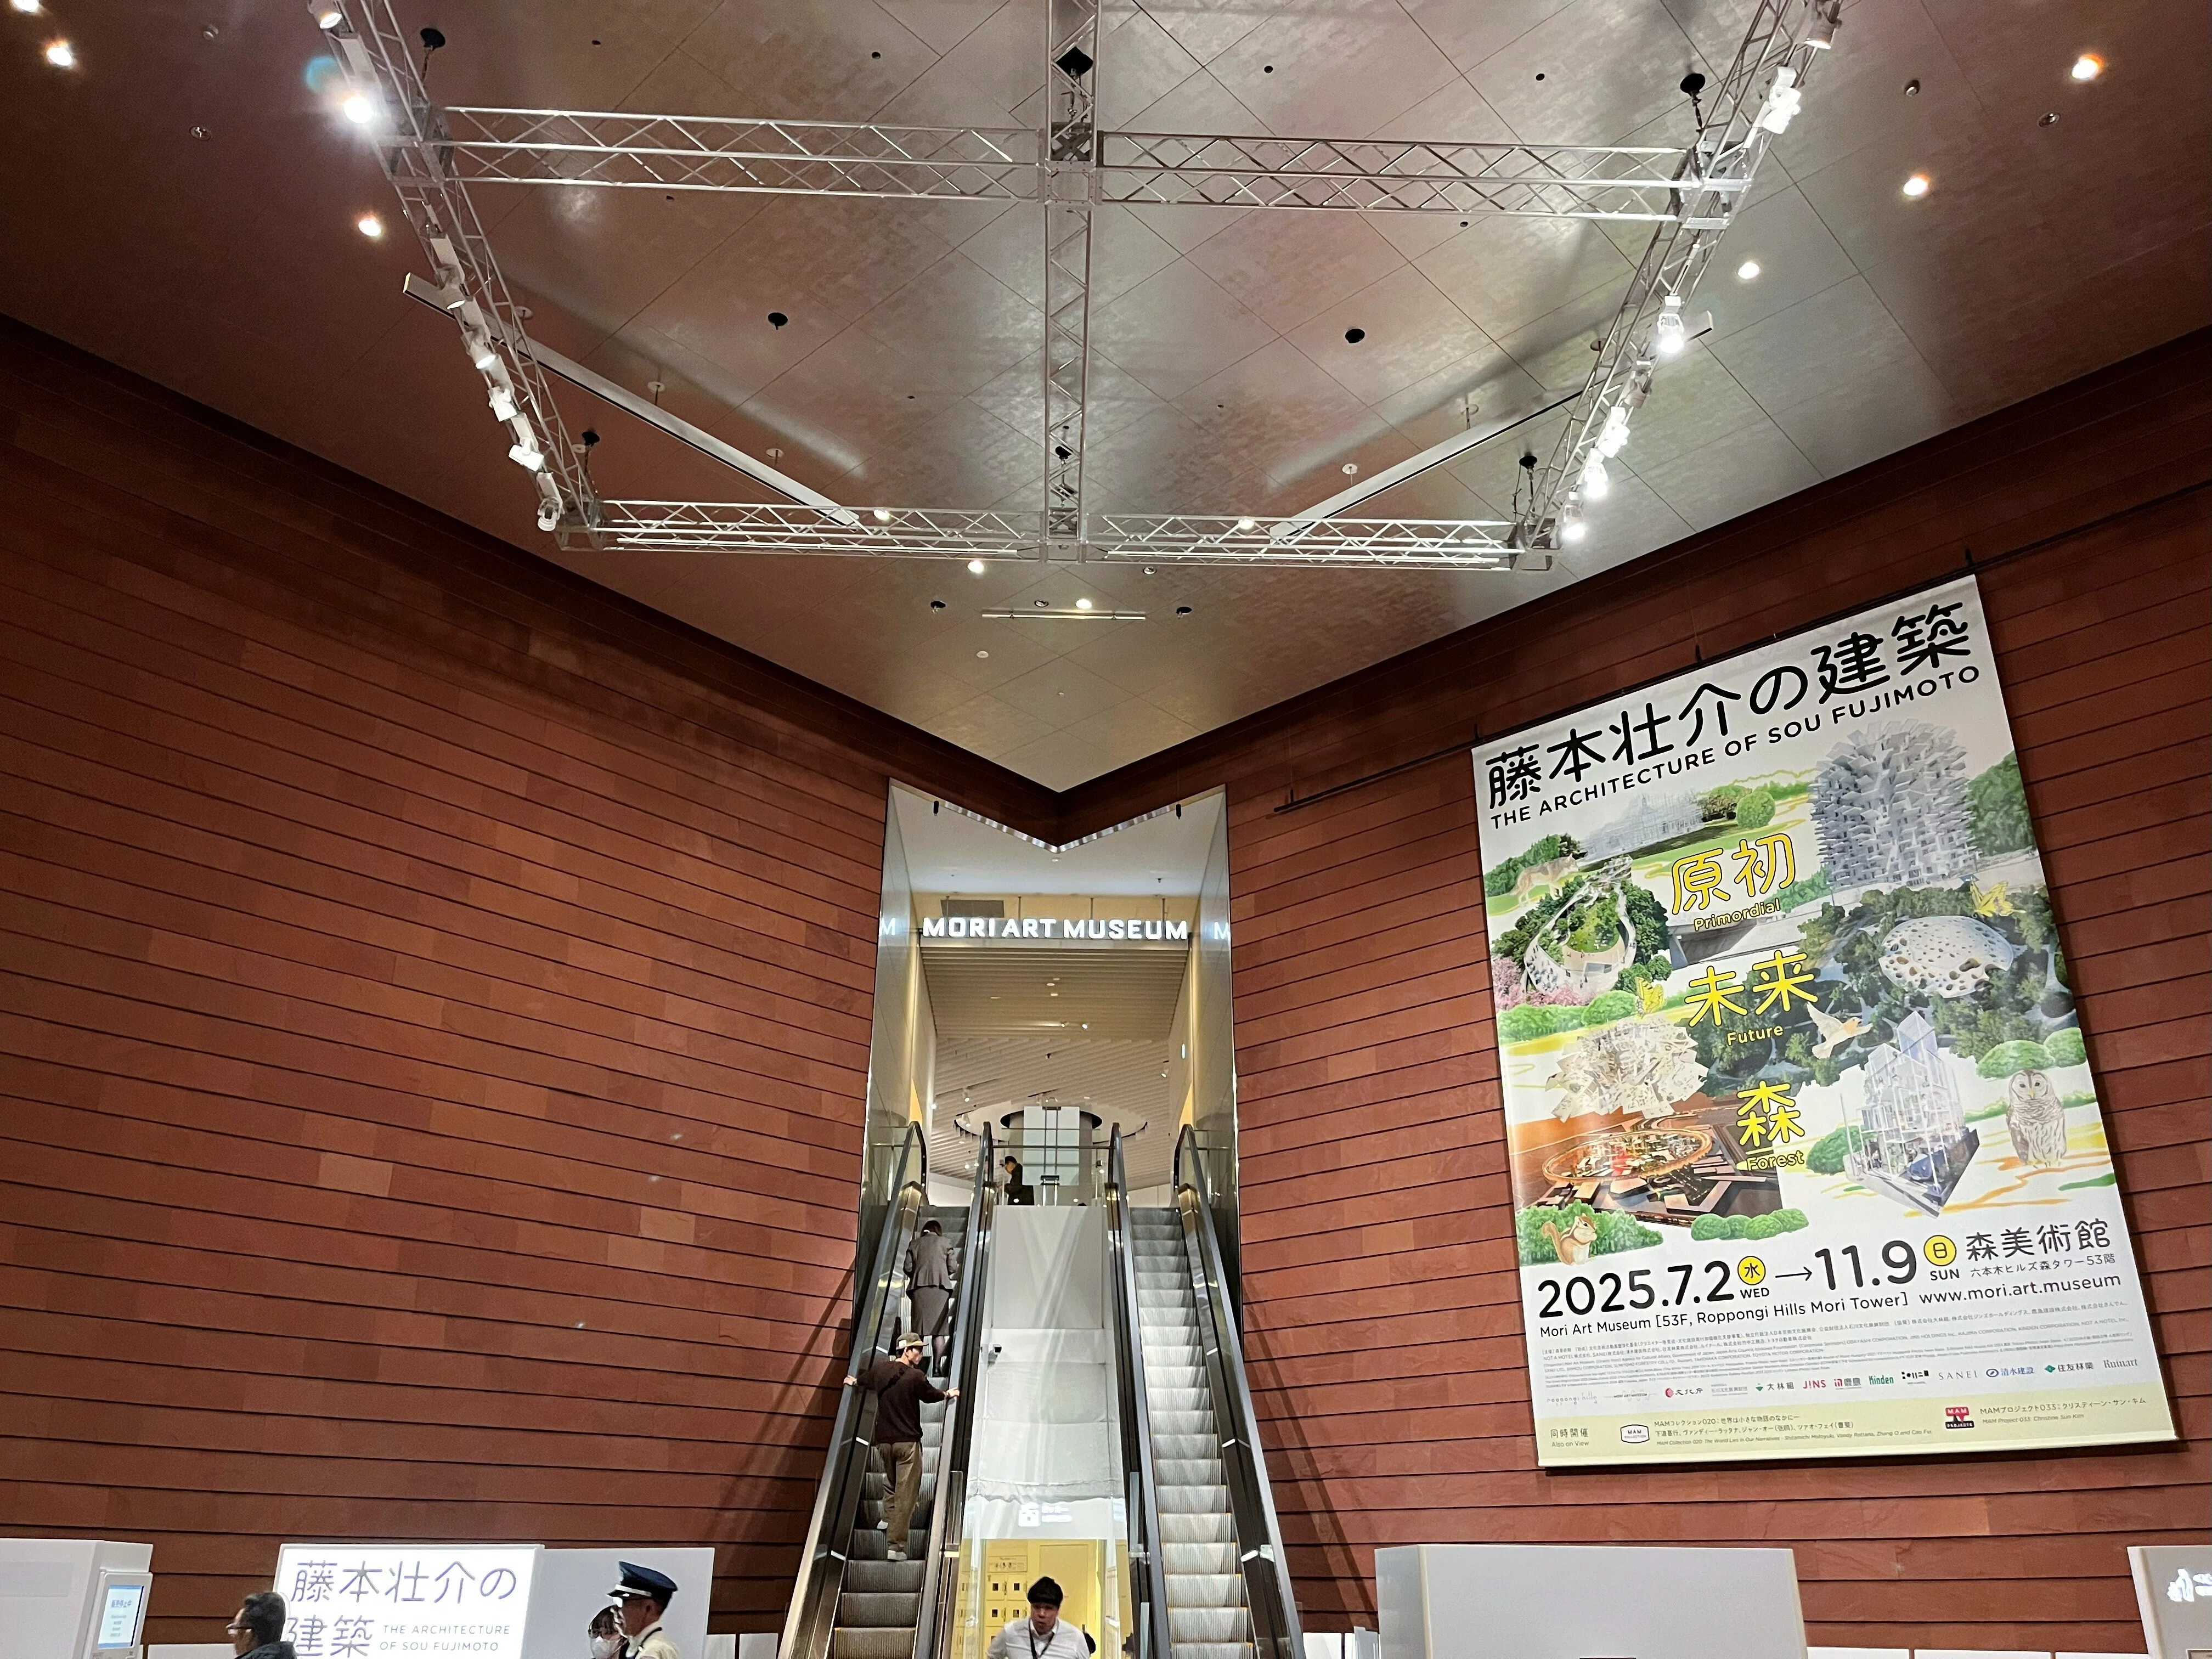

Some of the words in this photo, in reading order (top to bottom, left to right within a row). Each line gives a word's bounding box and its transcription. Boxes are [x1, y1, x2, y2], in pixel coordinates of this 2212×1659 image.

[1486, 602, 1971, 810] 藤本壮介の建築
[1491, 806, 1531, 829] THE
[1539, 747, 1716, 816] ARCHITECTURE
[1724, 733, 1757, 757] OF
[1768, 714, 1821, 743] SOU
[1832, 665, 1980, 724] FUJIMOTO
[1671, 832, 1797, 916] 原初
[1694, 898, 1781, 932] Primordial
[922, 917, 995, 937] MORI
[1002, 918, 1057, 938] ART
[1063, 918, 1188, 940] MUSEUM
[1685, 949, 1819, 1028] 未来
[1726, 1023, 1784, 1046] Future
[1737, 1080, 1805, 1147] 森
[1746, 1150, 1805, 1172] Forest
[1932, 1242, 1948, 1259] 日
[1965, 1217, 2111, 1262] 森美術館
[1744, 1263, 1760, 1279] 水
[1814, 1239, 1917, 1291] 11.9
[1930, 1268, 1960, 1282] SUN
[1970, 1253, 2116, 1278] 六本木ヒルズ森タワー53階
[1538, 1260, 1735, 1318] 2025.7.2
[1740, 1288, 1770, 1300] WED
[1918, 1274, 2121, 1304] www.mori.art.museum
[1540, 1325, 1568, 1338] Mori
[1572, 1323, 1593, 1335] Art
[1597, 1317, 1651, 1333] Museum
[1656, 1313, 1692, 1328] [53F,
[1697, 1305, 1769, 1323] Roppongi
[1774, 1302, 1805, 1317] Hills
[1811, 1299, 1846, 1314] Mori
[1849, 1291, 1909, 1310] Tower]
[1803, 1380, 1826, 1389] JINS
[1868, 1375, 1894, 1385] Kinden
[1938, 1370, 1977, 1380] SANEI
[1550, 1427, 1589, 1438] 同時開催
[290, 1560, 517, 1604] 藤本壮介の
[287, 1615, 375, 1658] 建築
[383, 1624, 406, 1634] THE
[411, 1624, 511, 1634] ARCHITECTURE
[380, 1641, 397, 1651] OF
[402, 1641, 428, 1651] SOU
[433, 1641, 499, 1651] FUJIMOTO
